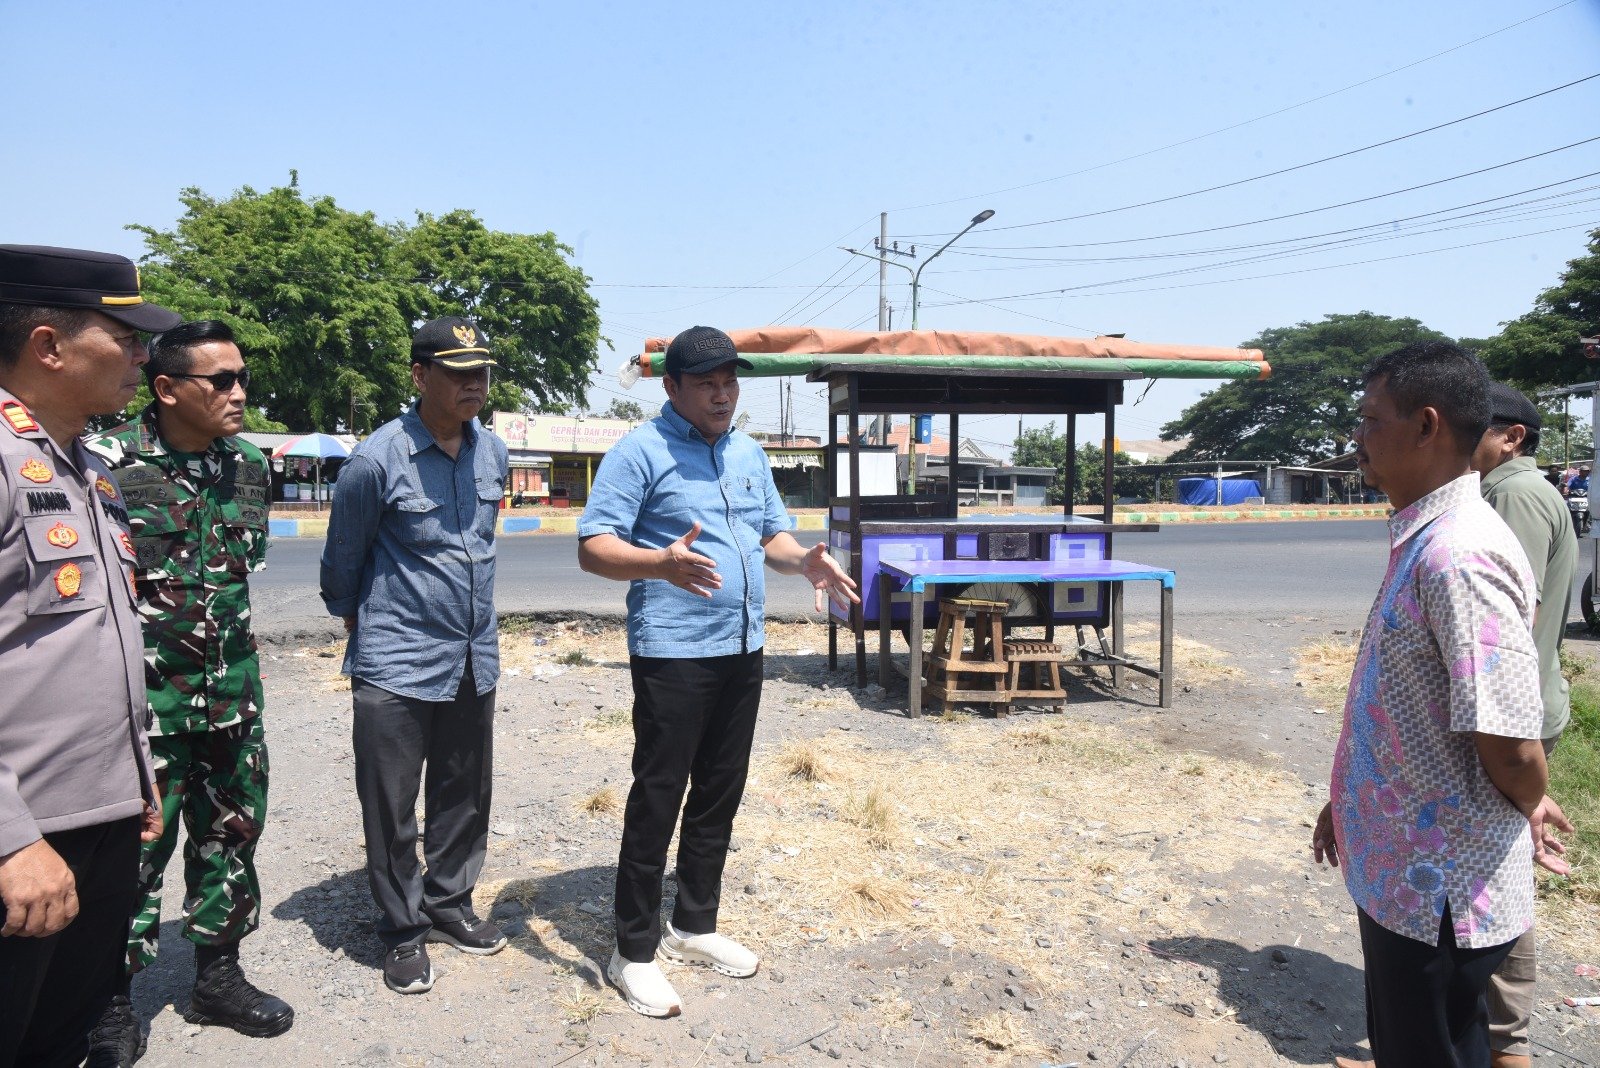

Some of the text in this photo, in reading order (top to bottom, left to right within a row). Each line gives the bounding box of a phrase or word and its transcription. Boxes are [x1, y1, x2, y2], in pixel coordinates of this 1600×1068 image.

[550, 426, 628, 437] GEPREK DAN PENYE
